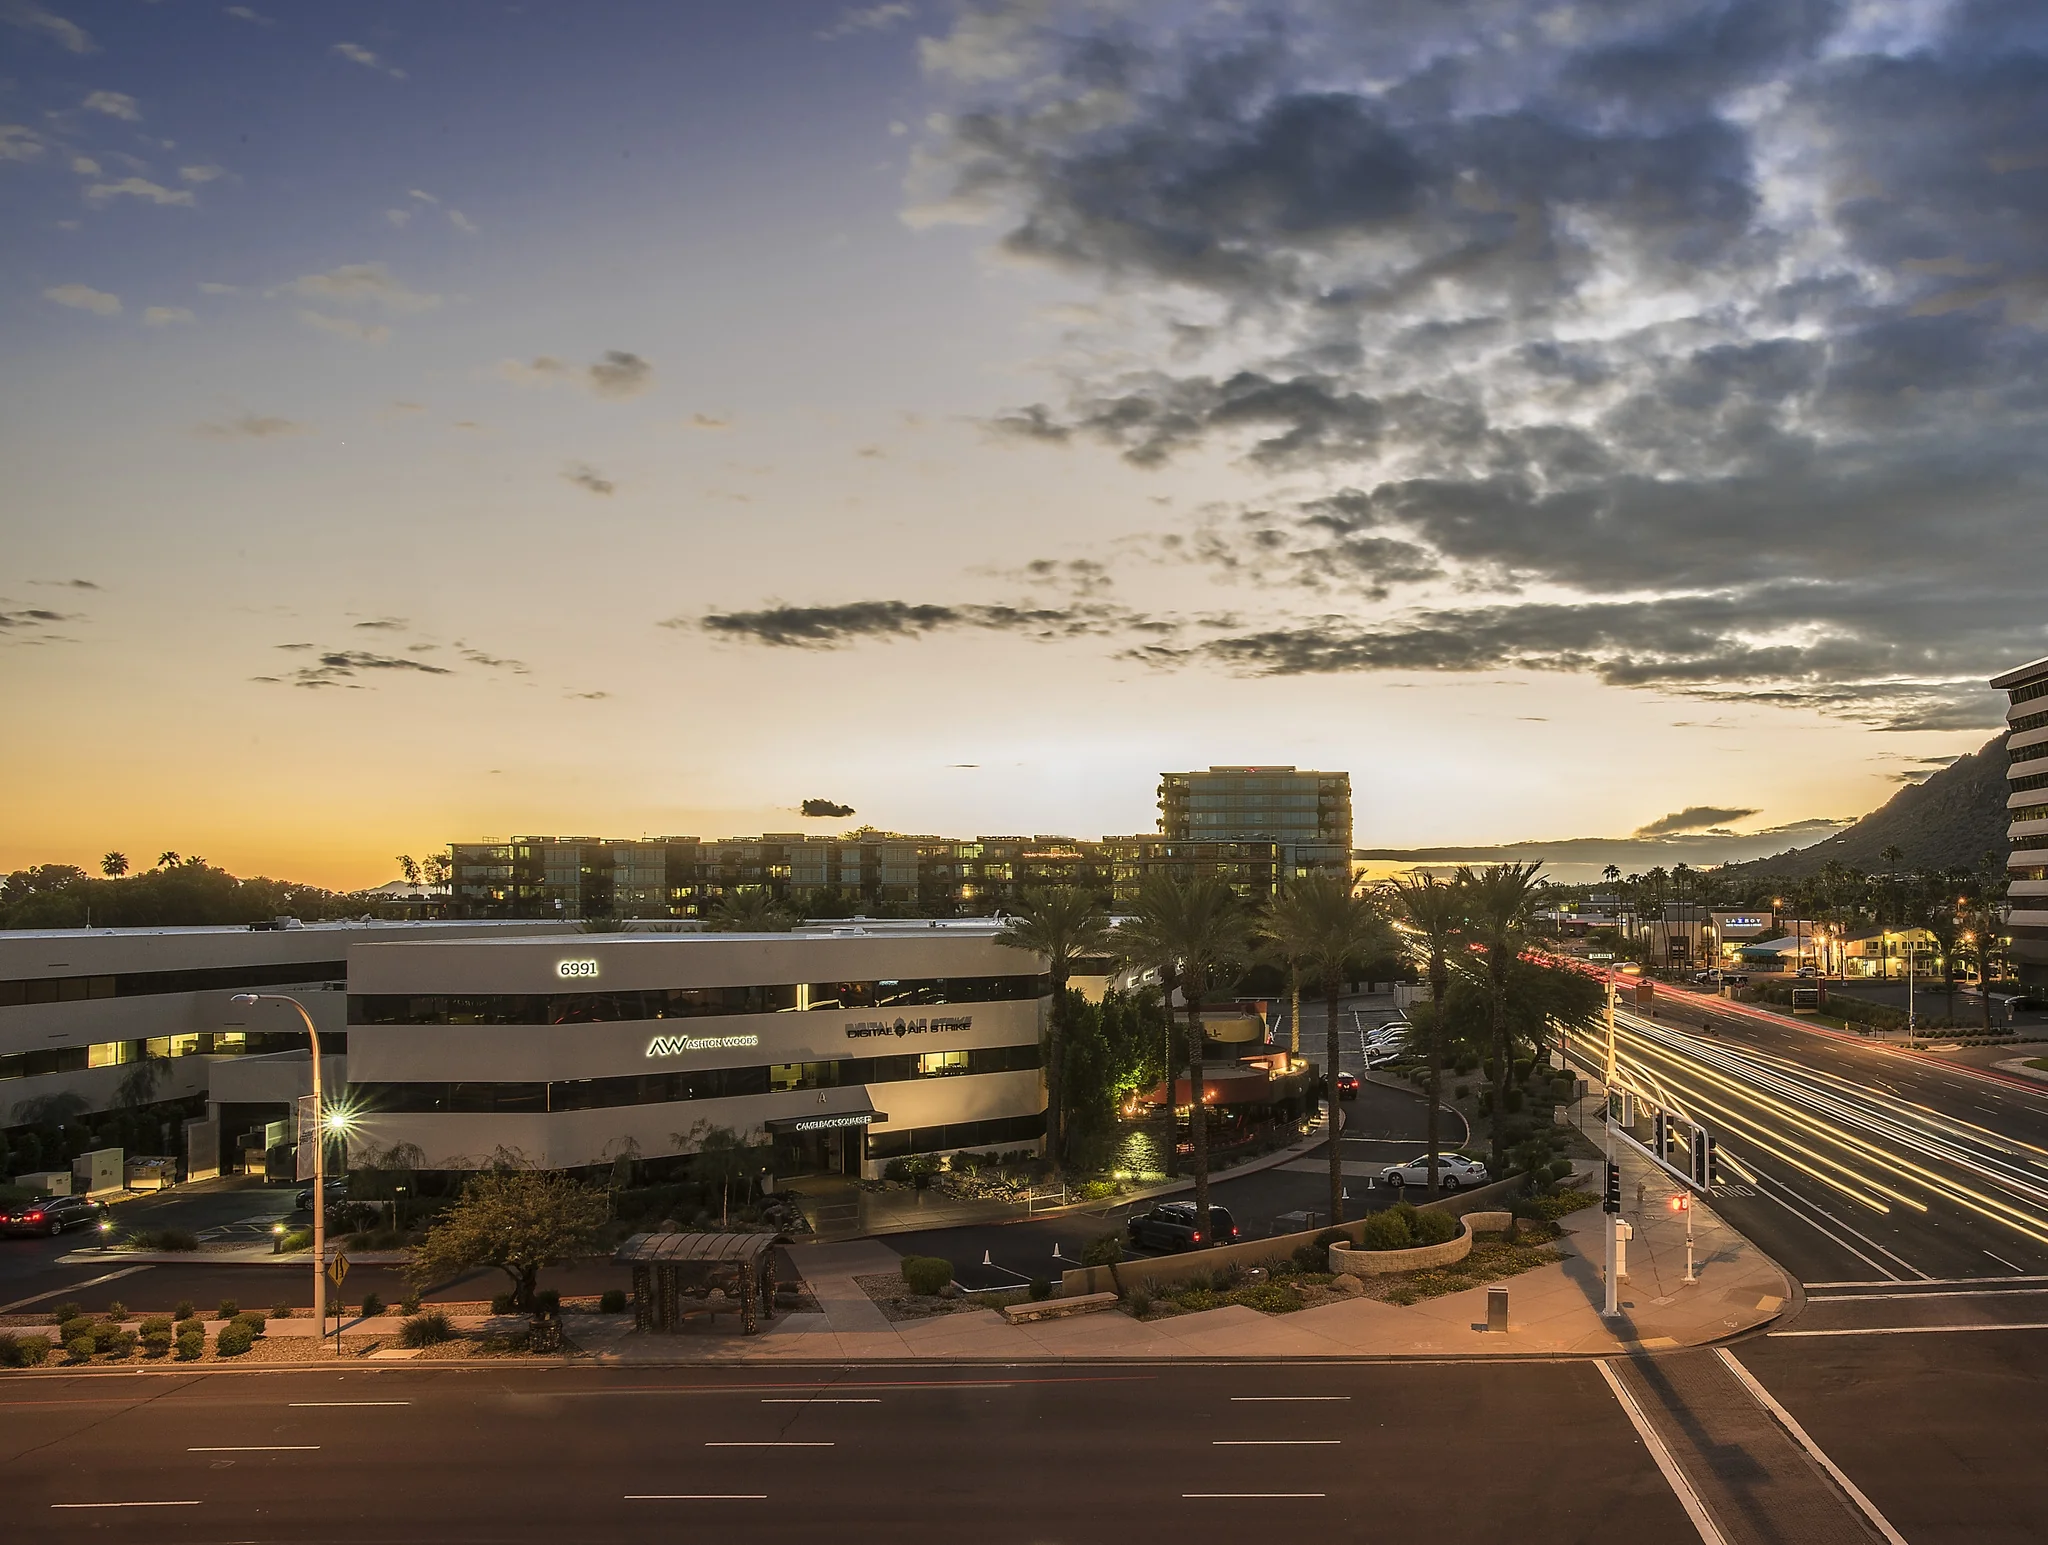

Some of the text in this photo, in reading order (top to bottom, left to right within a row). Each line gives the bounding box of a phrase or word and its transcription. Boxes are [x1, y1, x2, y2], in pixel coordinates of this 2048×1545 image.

[560, 962, 597, 975] 6991
[847, 1022, 972, 1039] DIGITAL AIR STRIKE
[688, 1039, 722, 1049] ASHTON
[723, 1037, 758, 1047] WOODS
[1708, 1184, 1756, 1198] ONLY
